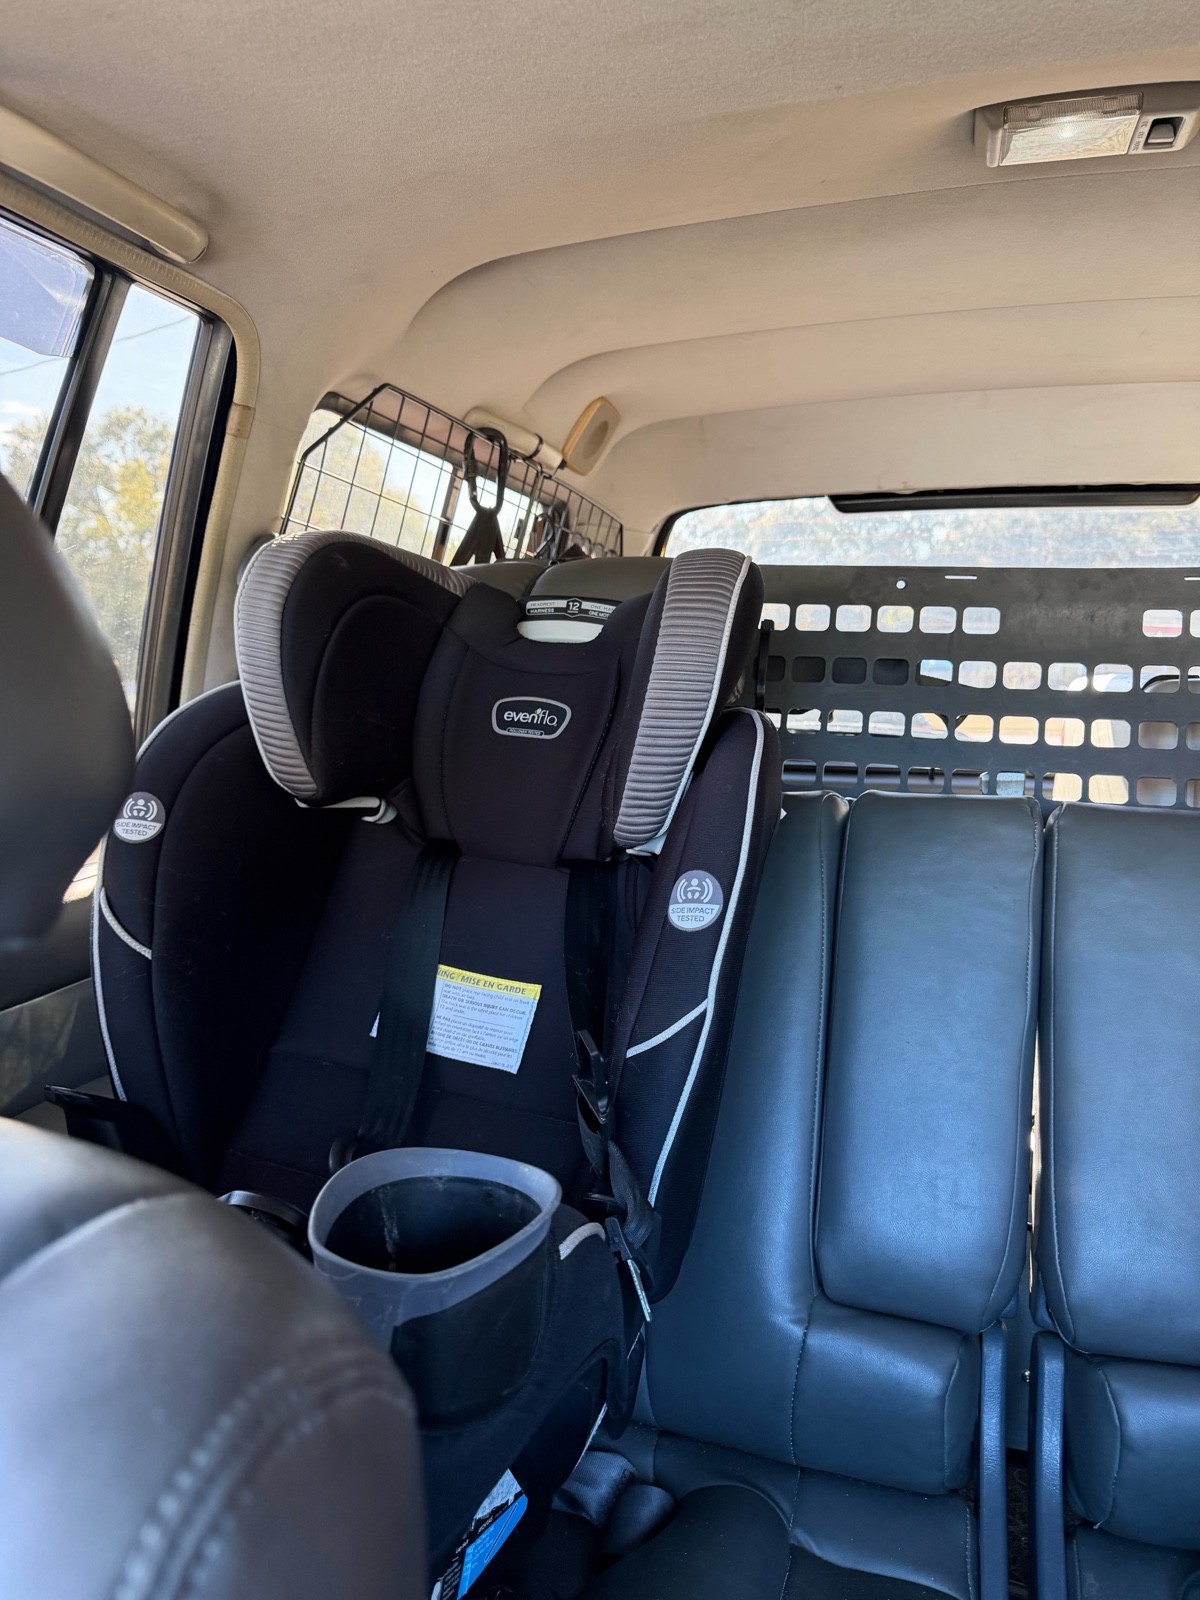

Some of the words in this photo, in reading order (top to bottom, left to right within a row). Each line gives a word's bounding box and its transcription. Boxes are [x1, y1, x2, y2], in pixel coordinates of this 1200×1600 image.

[568, 601, 580, 611] 12
[504, 708, 558, 726] evenflo
[131, 822, 158, 831] IMPACT
[122, 828, 148, 836] TESTED
[686, 907, 715, 915] IMPACT
[460, 975, 481, 986] MISE
[483, 980, 495, 989] EN
[496, 983, 527, 996] GARDE
[465, 999, 483, 1007] SERIOUS
